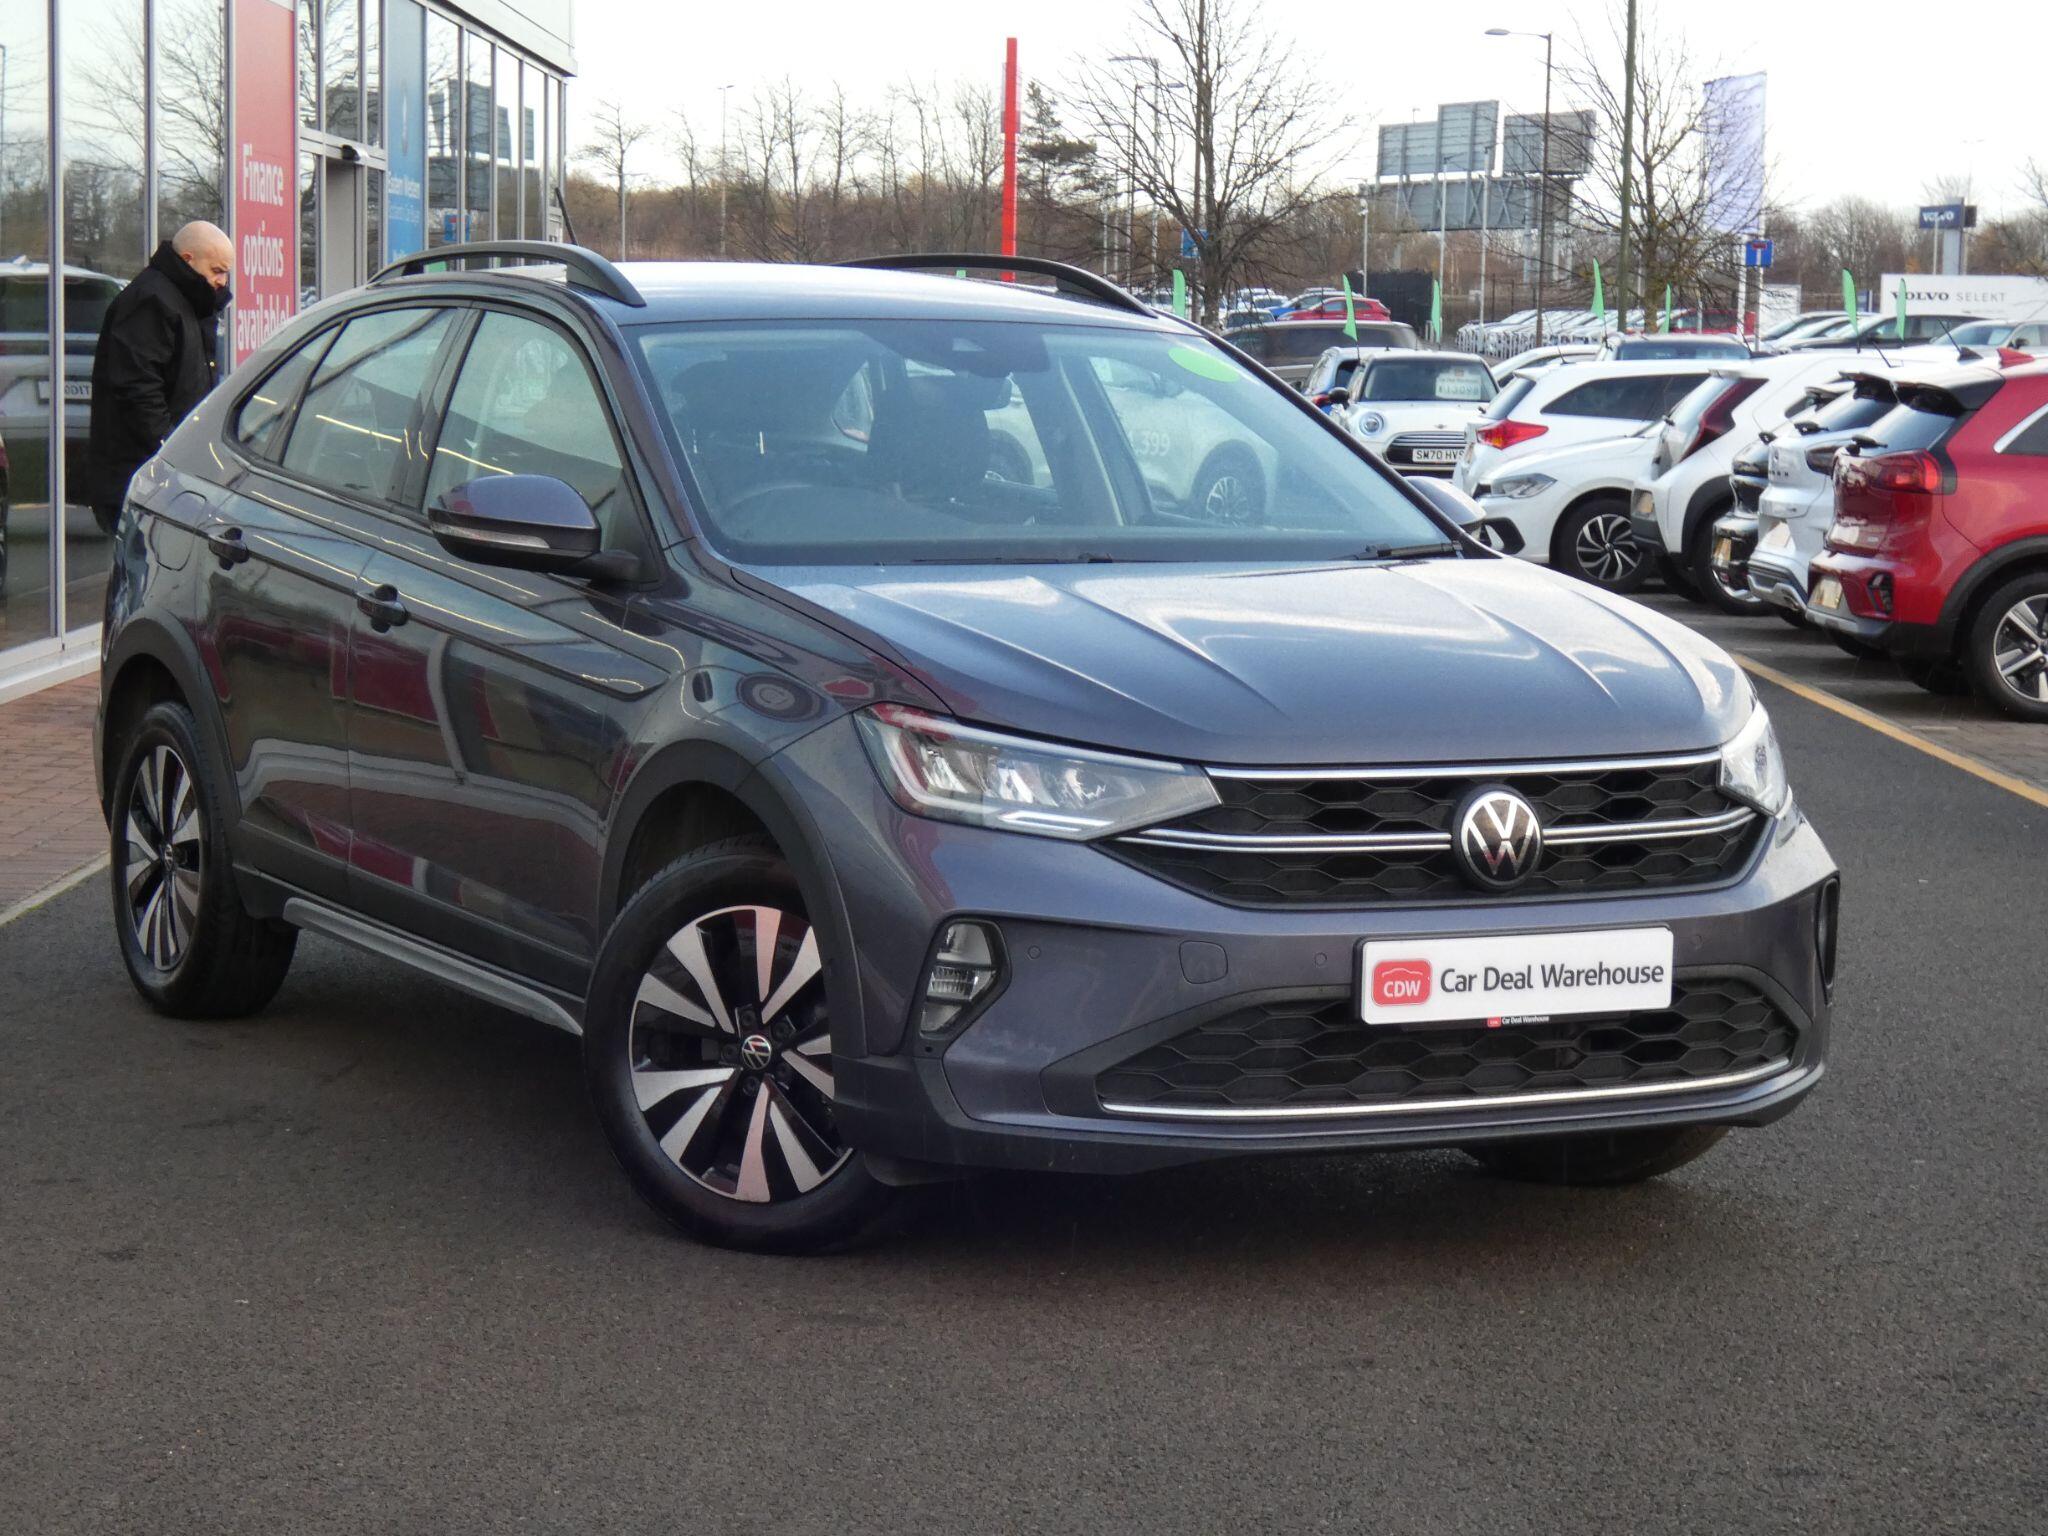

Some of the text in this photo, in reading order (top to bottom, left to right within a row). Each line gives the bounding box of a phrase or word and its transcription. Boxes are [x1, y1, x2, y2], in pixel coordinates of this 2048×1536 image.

[242, 143, 284, 206] Finance
[242, 220, 284, 293] options
[1383, 979, 1421, 998] CDW
[1440, 961, 1664, 993] Car Deal Warehouse
